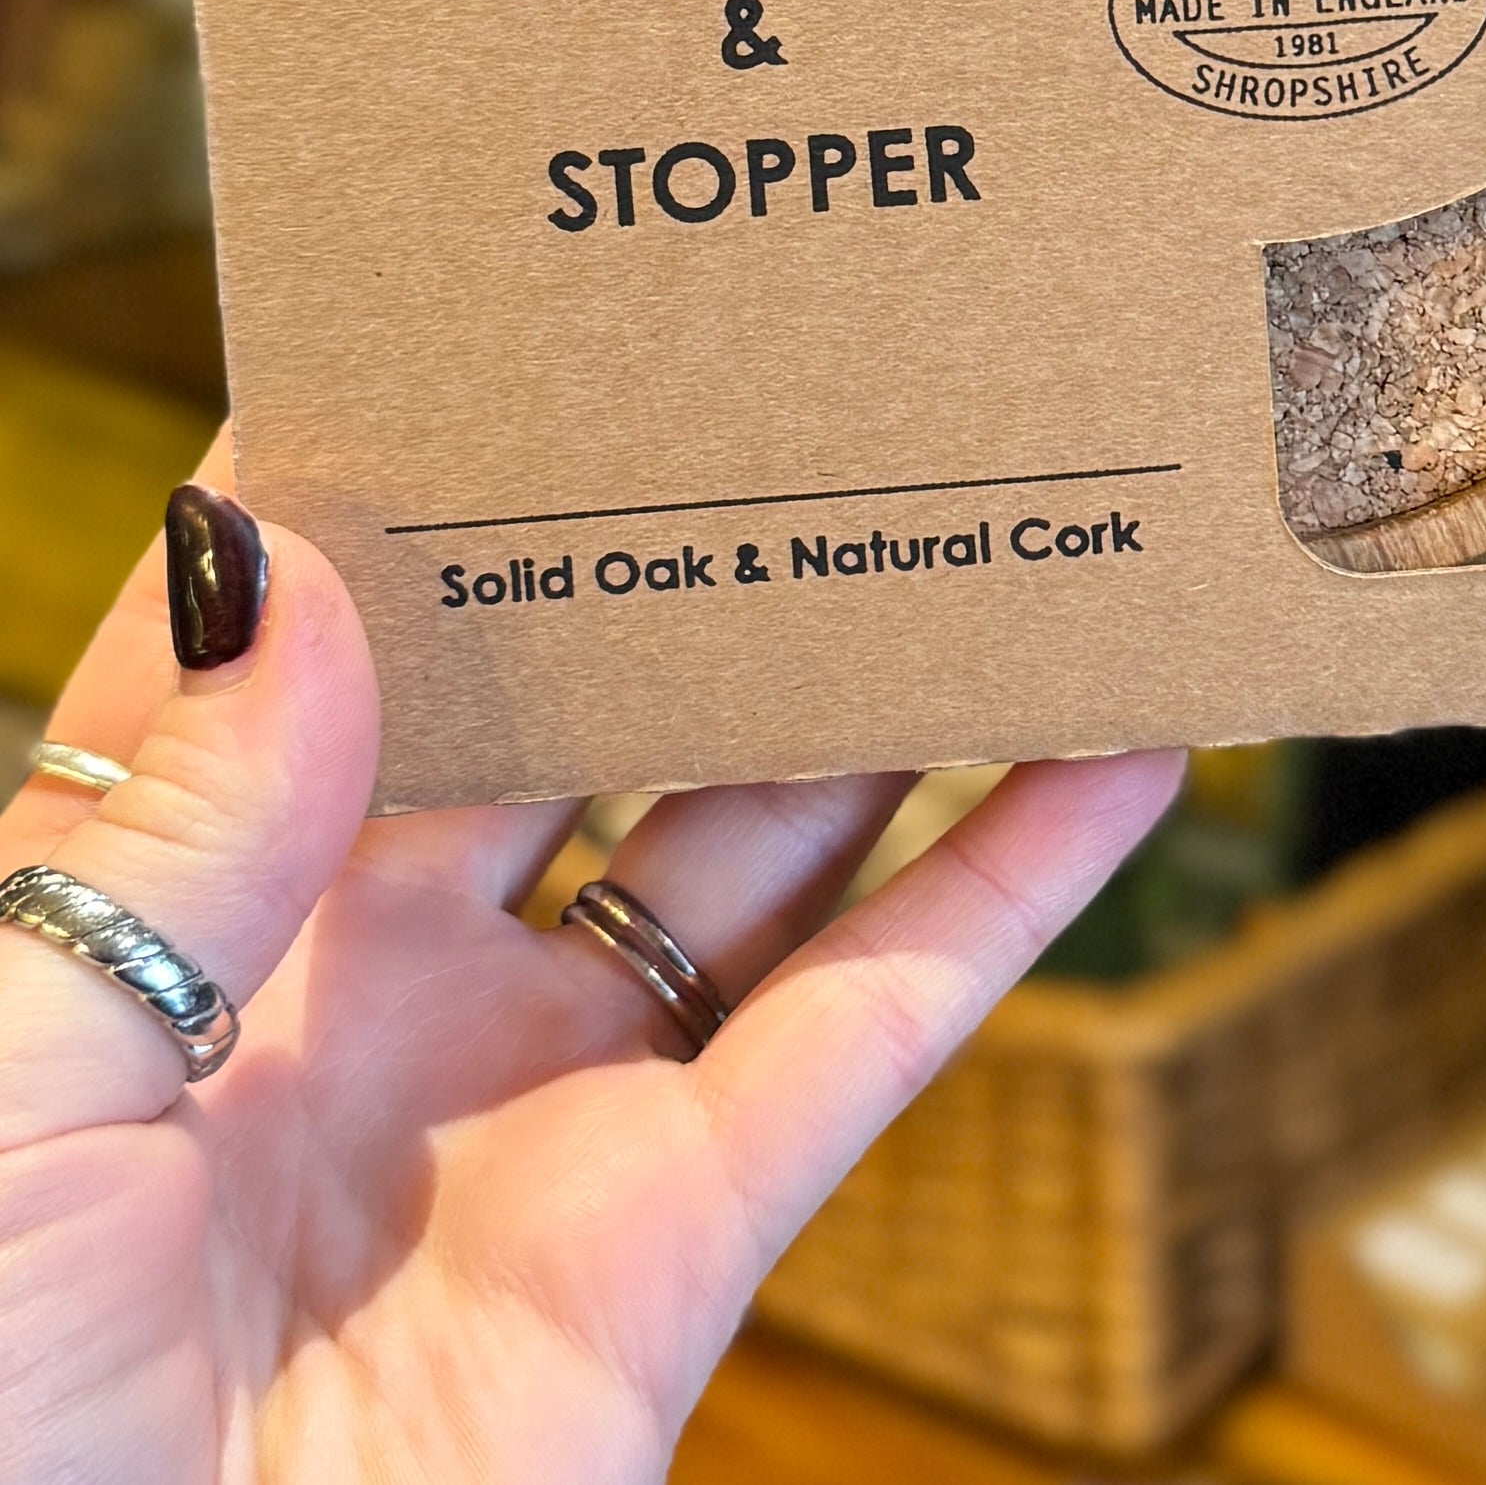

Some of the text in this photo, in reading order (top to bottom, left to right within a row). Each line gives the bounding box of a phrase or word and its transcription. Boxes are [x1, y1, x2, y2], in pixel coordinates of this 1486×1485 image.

[1191, 45, 1430, 108] SHROPSHIRE
[1275, 31, 1339, 58] 1981
[547, 124, 982, 233] STOPPER
[440, 511, 1144, 609] Solid Oak & Natural Cork
